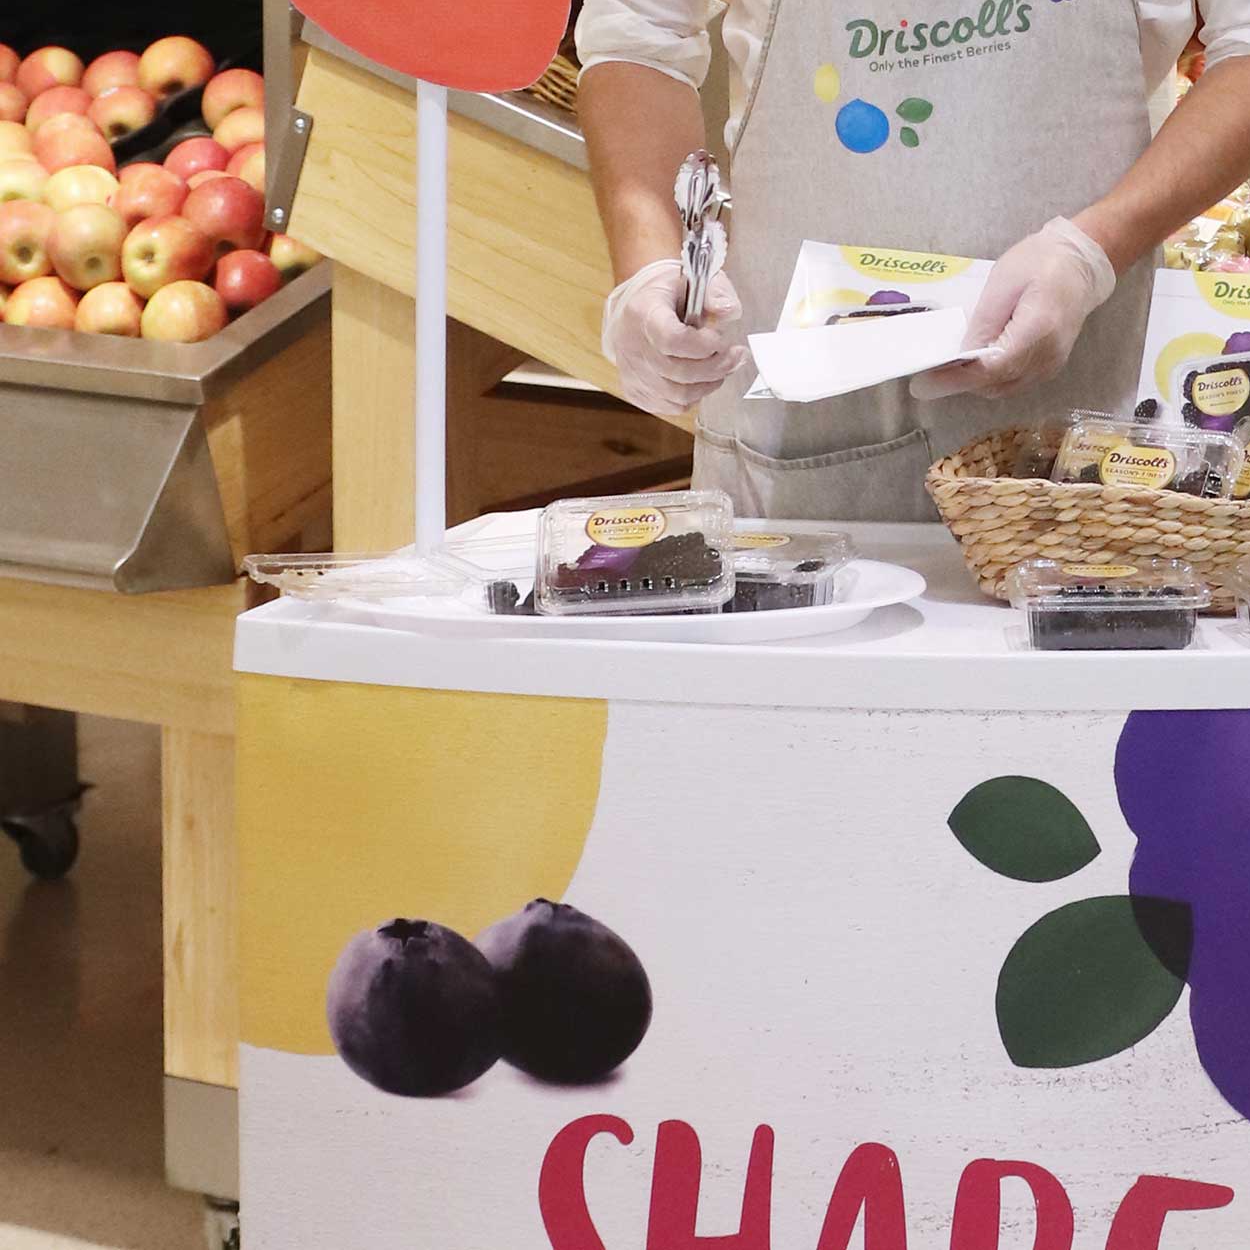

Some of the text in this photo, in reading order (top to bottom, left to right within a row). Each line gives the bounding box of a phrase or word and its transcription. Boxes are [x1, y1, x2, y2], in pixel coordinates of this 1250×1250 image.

[869, 41, 1012, 73] Only the Finest Berries
[860, 253, 948, 274] Driscoll's
[1197, 376, 1243, 392] Driscoll's
[1109, 452, 1170, 469] Driscoll's
[592, 513, 658, 527] Driscoll's
